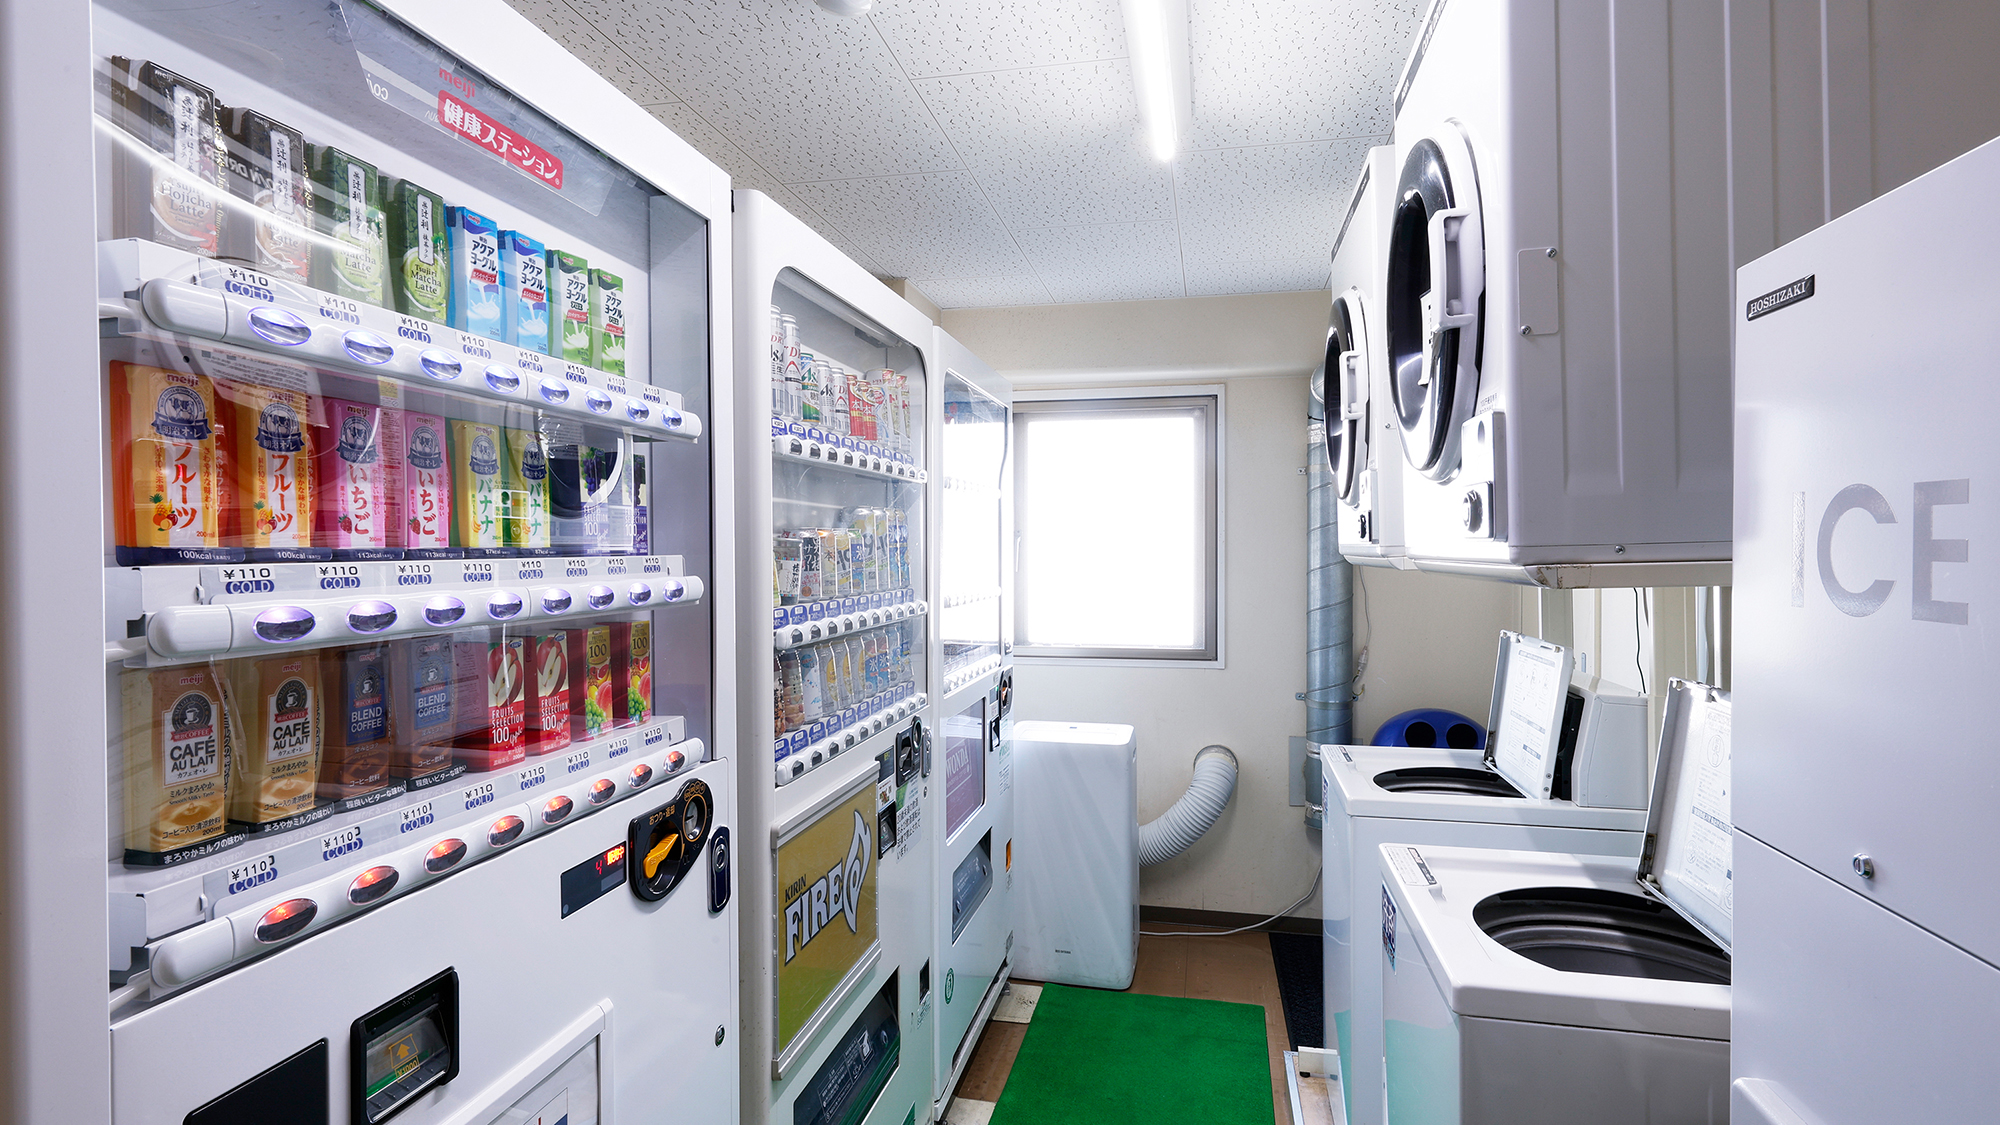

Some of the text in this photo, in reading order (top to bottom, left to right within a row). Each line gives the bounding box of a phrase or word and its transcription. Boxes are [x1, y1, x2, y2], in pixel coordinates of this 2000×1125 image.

[439, 67, 476, 98] meiji
[444, 98, 558, 181] 健康ステーション
[162, 184, 212, 210] Hojicha
[170, 199, 205, 219] Latte
[468, 214, 481, 224] meiji
[472, 240, 495, 257] アクア
[519, 237, 530, 246] meiji
[345, 256, 372, 273] Latte
[415, 264, 437, 278] Tsujiri
[523, 261, 543, 276] アクア
[229, 268, 268, 287] ¥110
[411, 270, 441, 287] Matcha
[228, 280, 272, 302] COLD
[415, 280, 438, 294] Latte
[568, 279, 585, 291] アクア
[324, 296, 357, 313] ¥110
[606, 295, 621, 307] アクア
[1750, 281, 1807, 316] HOSHIZAKI
[400, 316, 428, 331] ¥110
[400, 327, 430, 343] COLD
[461, 334, 484, 348] ¥110
[464, 345, 490, 359] COLD
[519, 351, 539, 363] ¥110
[519, 359, 542, 373] COLD
[567, 363, 584, 375] ¥110
[166, 374, 199, 386] meiji
[567, 372, 586, 384] COLD
[267, 390, 294, 403] meiji
[347, 405, 370, 417] meiji
[416, 416, 436, 426] meiji
[172, 442, 197, 529] フルーツ
[272, 454, 293, 532] フルーツ
[350, 464, 370, 535] いちご
[418, 470, 436, 535] いちご
[478, 478, 493, 535] バナナ
[530, 482, 542, 536] バナナ
[585, 522, 599, 536] 100
[178, 550, 212, 560] 100kcal
[277, 551, 305, 560] 100kcal
[1791, 478, 1969, 625] ICE
[319, 566, 358, 576] ¥110
[399, 564, 431, 573] ¥110
[464, 563, 491, 572] ¥110
[521, 561, 542, 569] ¥110
[223, 568, 271, 579] ¥110
[465, 572, 491, 582] COLD
[520, 570, 542, 579] COLD
[567, 568, 587, 577] COLD
[322, 578, 358, 589] COLD
[400, 575, 430, 585] COLD
[229, 581, 272, 594] COLD
[589, 643, 607, 658] 100
[632, 637, 648, 650] 100
[282, 662, 301, 673] meiji
[180, 674, 203, 685] meiji
[418, 693, 446, 708] BLEND
[541, 696, 560, 708] FRUITS
[352, 706, 382, 723] BLEND
[418, 704, 446, 717] COFFEE
[492, 706, 514, 719] FRUITS
[541, 702, 568, 717] SELECTION
[351, 719, 382, 733] COFFEE
[492, 714, 524, 729] SELECTION
[542, 714, 557, 731] 100
[273, 718, 310, 741] CAFÉ
[492, 726, 509, 744] 100
[644, 728, 661, 738] ¥110
[273, 735, 310, 751] AU LAIT
[609, 739, 627, 750] ¥110
[645, 735, 662, 746] COLD
[170, 736, 215, 761] CAFÉ
[609, 747, 628, 758] COLD
[171, 754, 215, 773] AU LAIT
[418, 755, 444, 768] コーヒー飲料
[567, 751, 588, 763] ¥110
[272, 760, 308, 774] ミルクまろやか
[520, 766, 545, 779] ¥110
[568, 760, 590, 773] COLD
[350, 774, 380, 787] コーヒー飲料
[521, 776, 545, 790] COLD
[170, 782, 214, 798] ミルクまろやか
[465, 784, 493, 799] ¥110
[297, 801, 312, 810] 200ml
[466, 793, 494, 810] COLD
[265, 807, 332, 832] まろやかミルクの味わい
[402, 814, 432, 833] COLD
[202, 825, 222, 836] 200ml
[164, 832, 245, 864] まろやかミルクの味わい
[325, 839, 362, 861] COLD
[232, 868, 275, 894] COLD
[784, 874, 807, 903] KIRIN
[784, 857, 844, 966] FIRE
